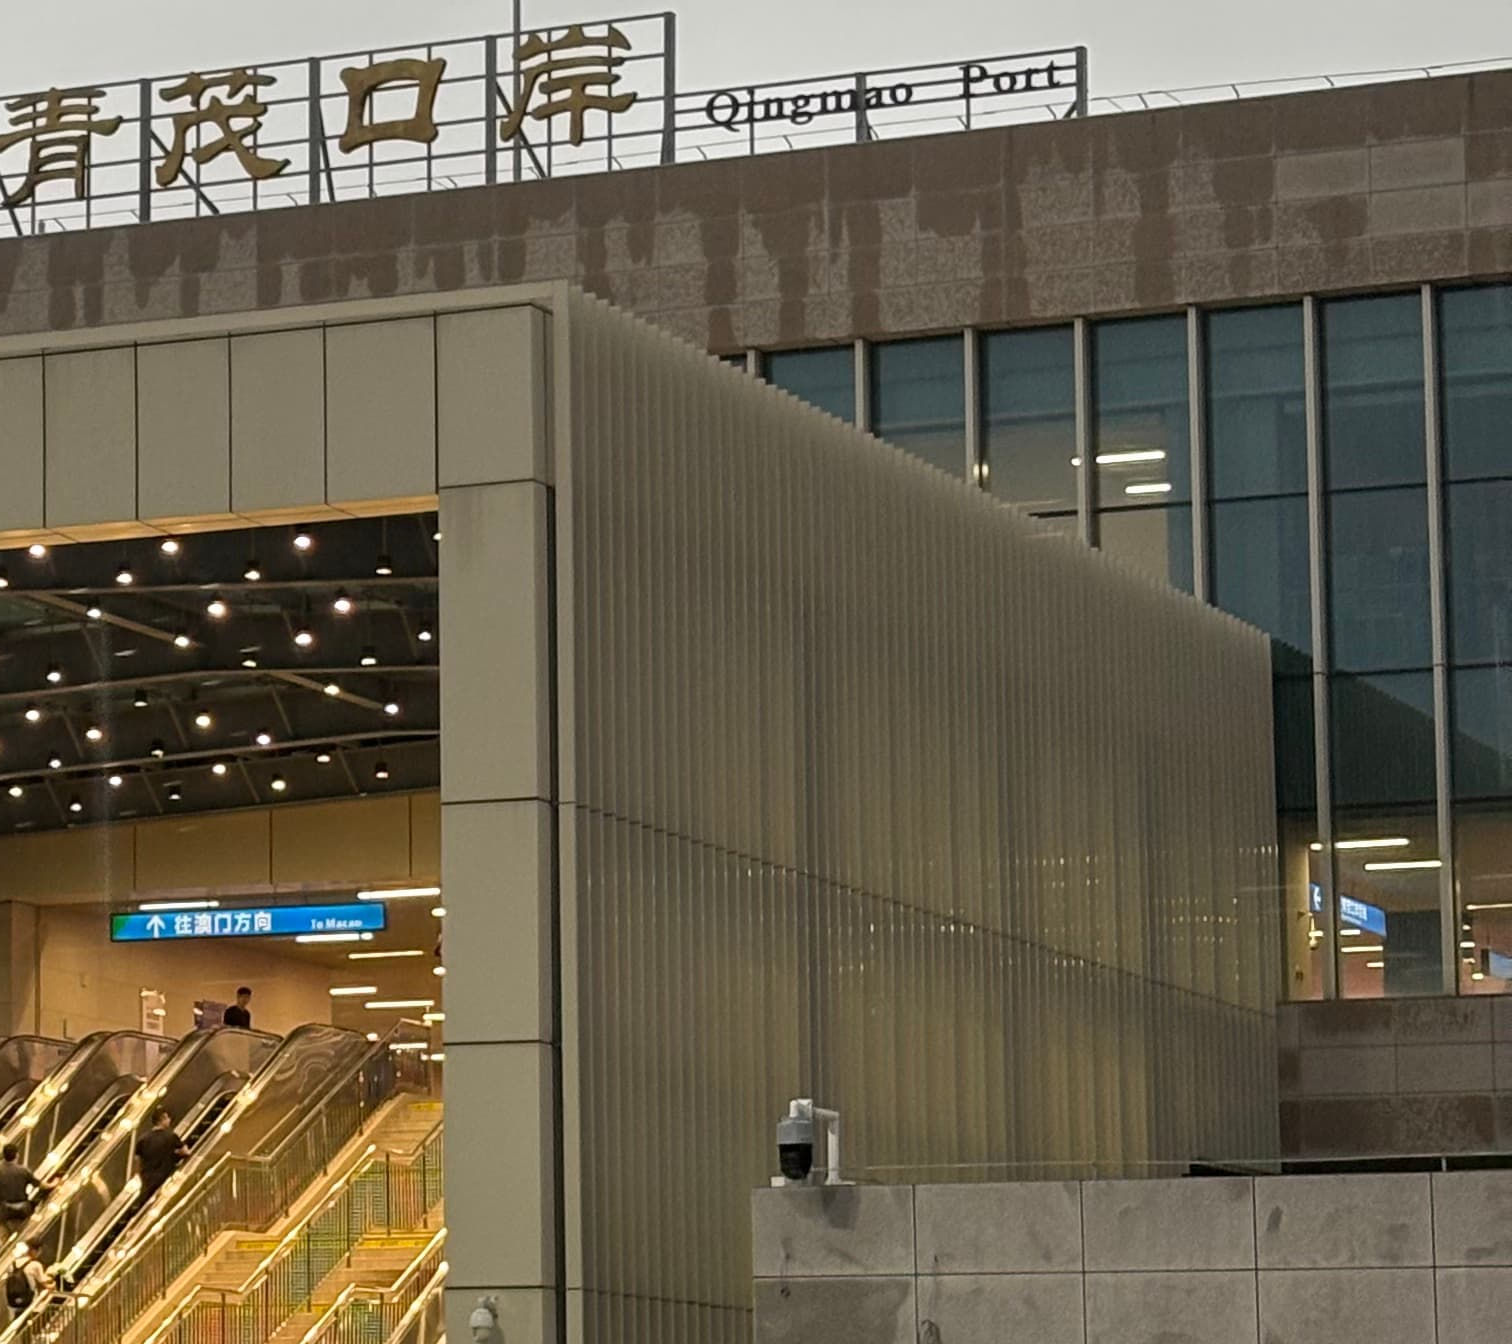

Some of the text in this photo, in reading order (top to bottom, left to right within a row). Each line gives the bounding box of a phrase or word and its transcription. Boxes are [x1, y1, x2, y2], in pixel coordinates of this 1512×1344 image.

[705, 60, 1062, 132] Qingmao Port
[174, 911, 272, 935] 往澳门方向
[311, 918, 324, 929] To
